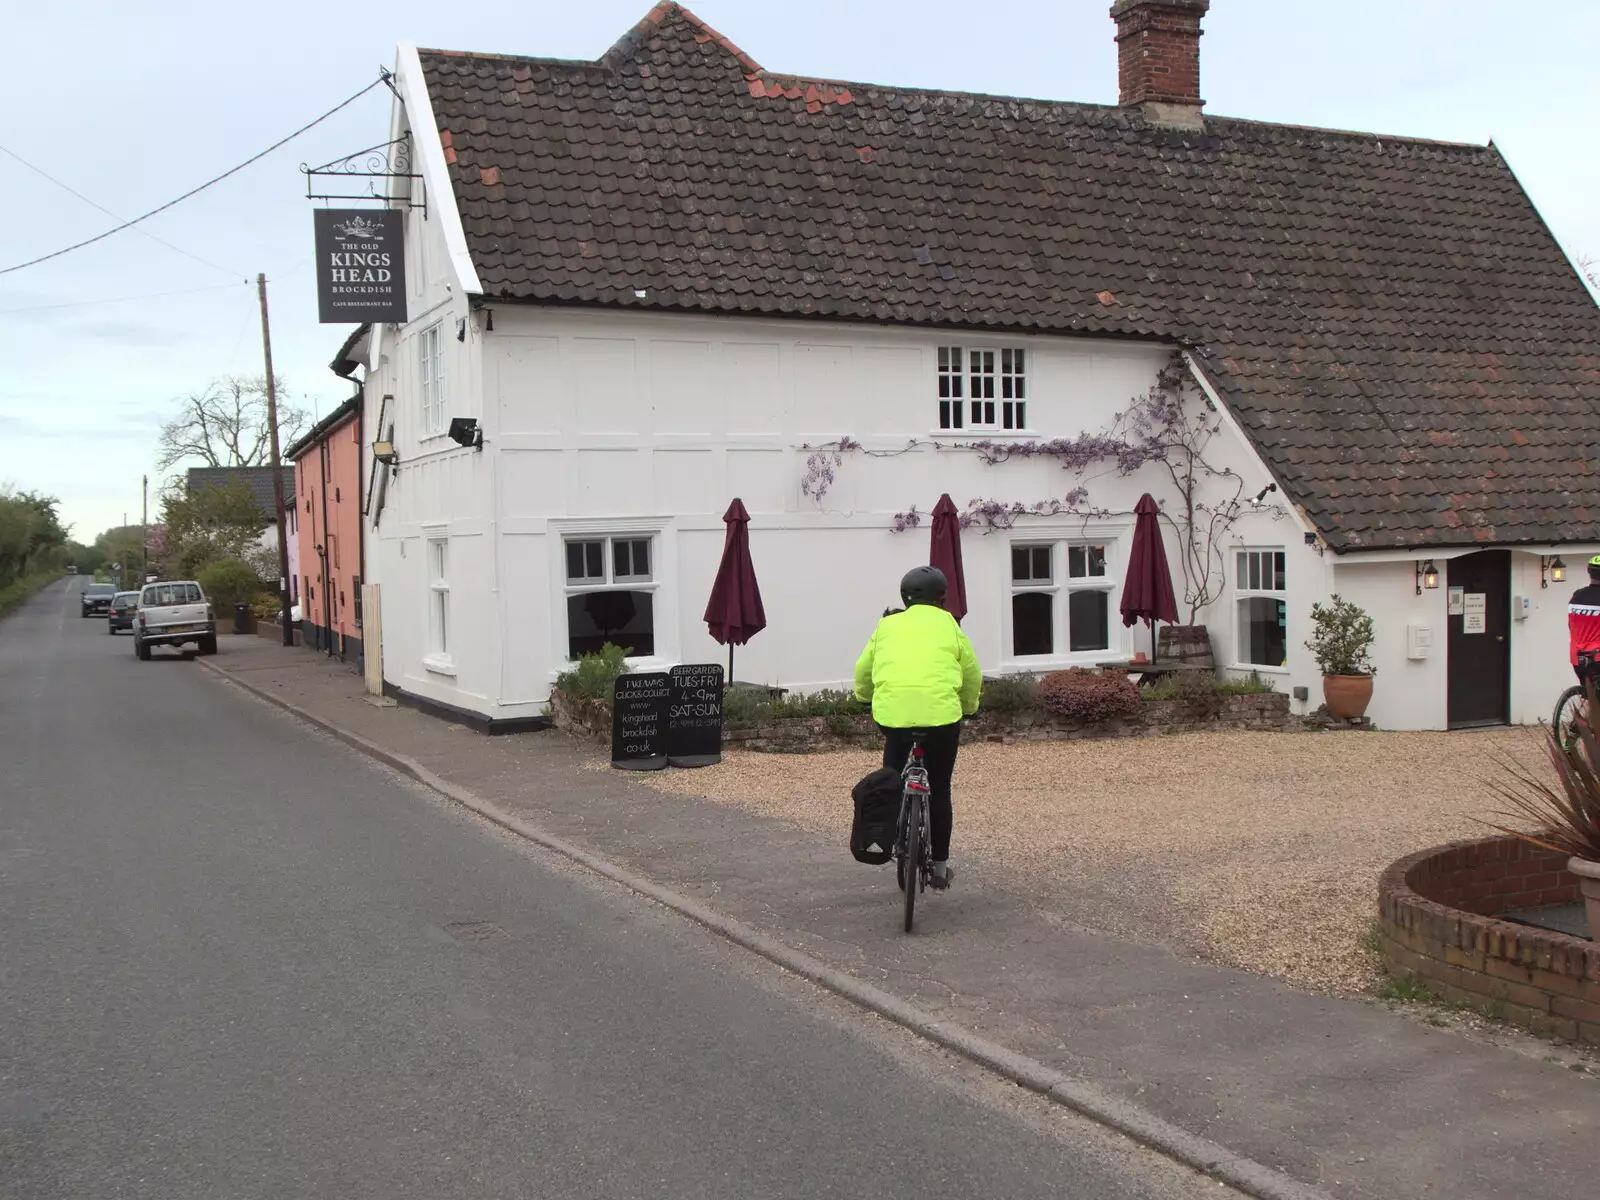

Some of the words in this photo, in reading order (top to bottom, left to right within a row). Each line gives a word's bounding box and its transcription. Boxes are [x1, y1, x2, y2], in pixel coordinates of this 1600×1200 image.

[331, 253, 390, 266] KINGS
[331, 269, 391, 282] HEAD
[669, 703, 720, 717] SAT-SUN
[622, 711, 658, 725] kingshead
[622, 725, 657, 738] brockdish
